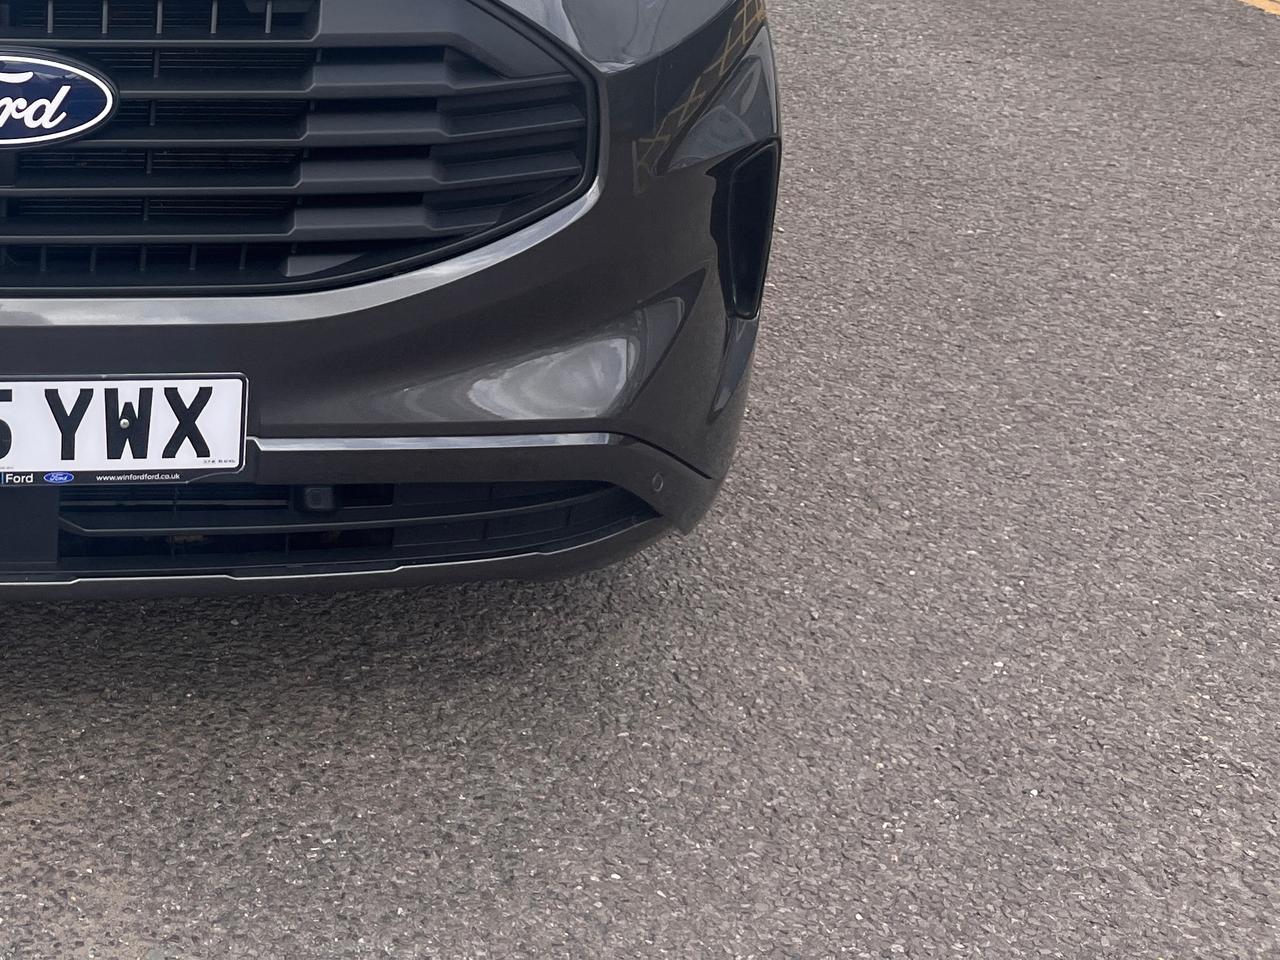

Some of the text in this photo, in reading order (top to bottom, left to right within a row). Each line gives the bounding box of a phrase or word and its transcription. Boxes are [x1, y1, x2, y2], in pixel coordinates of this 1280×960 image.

[43, 386, 213, 461] YWX
[5, 473, 34, 483] Ford
[95, 472, 180, 481] www.winfordford.co.uk
